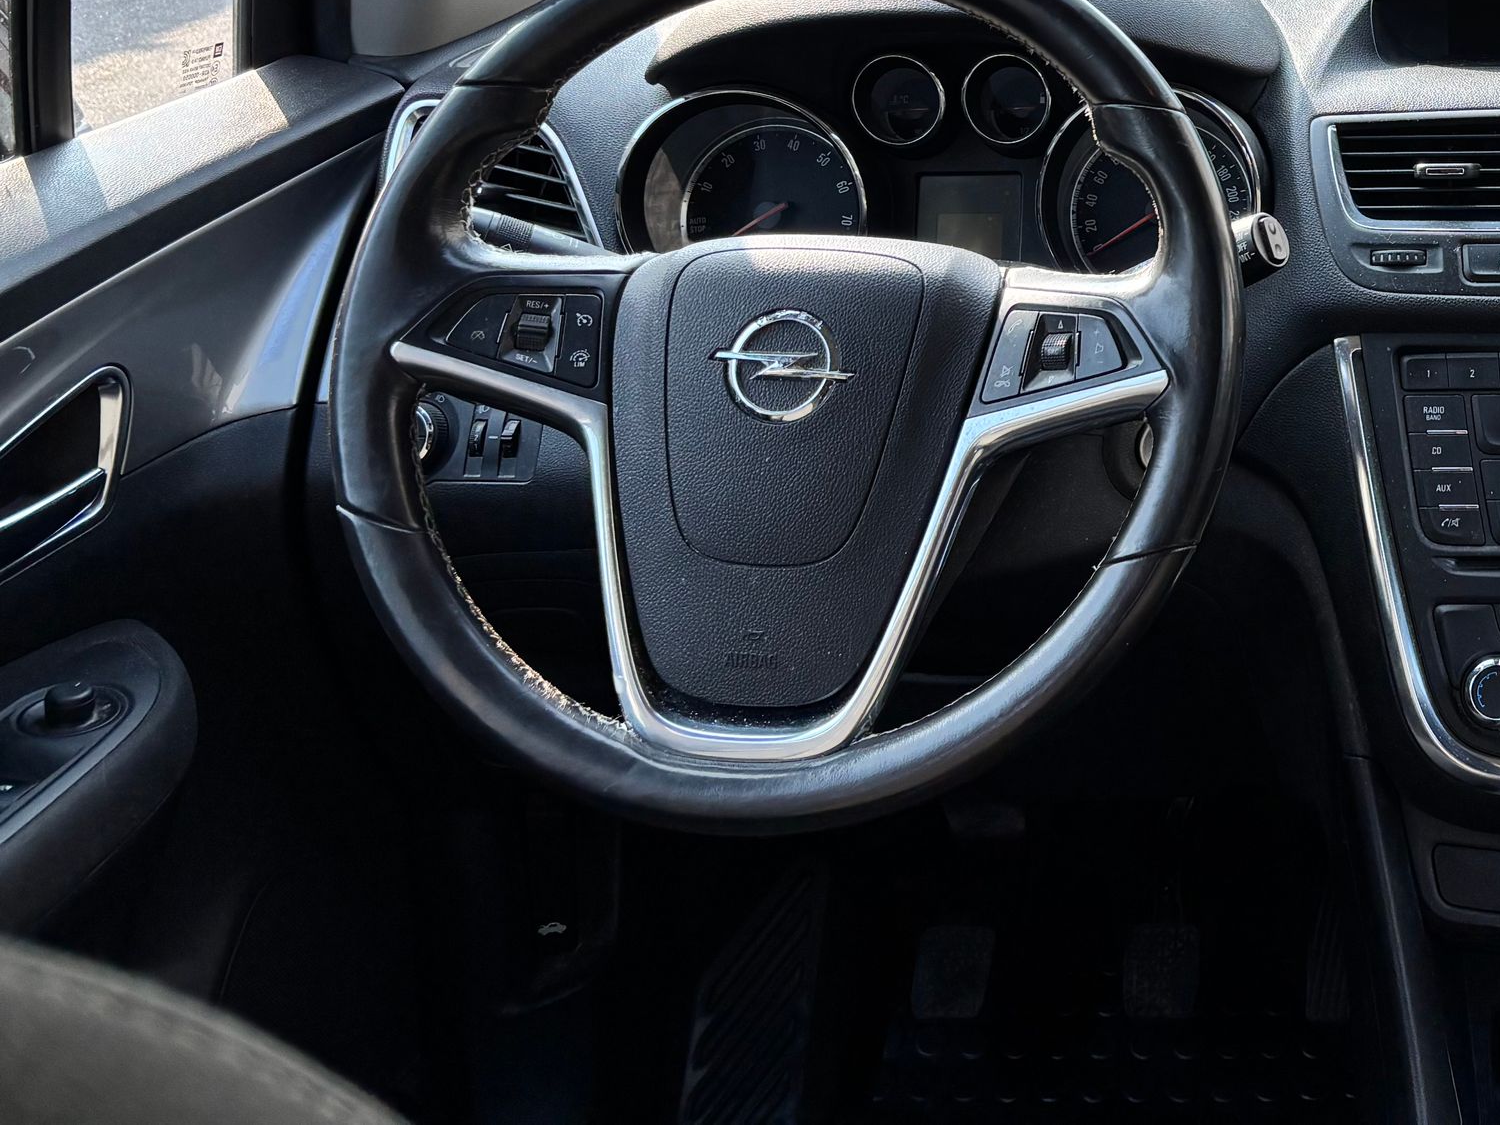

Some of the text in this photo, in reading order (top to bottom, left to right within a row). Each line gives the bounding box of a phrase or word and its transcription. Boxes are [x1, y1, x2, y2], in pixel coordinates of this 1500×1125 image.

[753, 139, 766, 152] 30
[787, 139, 800, 152] 40
[721, 154, 735, 168] 20
[816, 153, 831, 167] 50
[1093, 170, 1108, 185] 60
[1216, 164, 1232, 182] 180
[701, 181, 713, 193] 10
[836, 180, 850, 194] 60
[1085, 193, 1098, 207] 40
[1225, 185, 1239, 203] 200
[841, 214, 853, 226] 70
[1084, 219, 1098, 233] 20
[1469, 369, 1475, 378] 2
[1423, 406, 1445, 414] RADIO
[1431, 447, 1442, 455] CD
[1435, 483, 1452, 492] AUX
